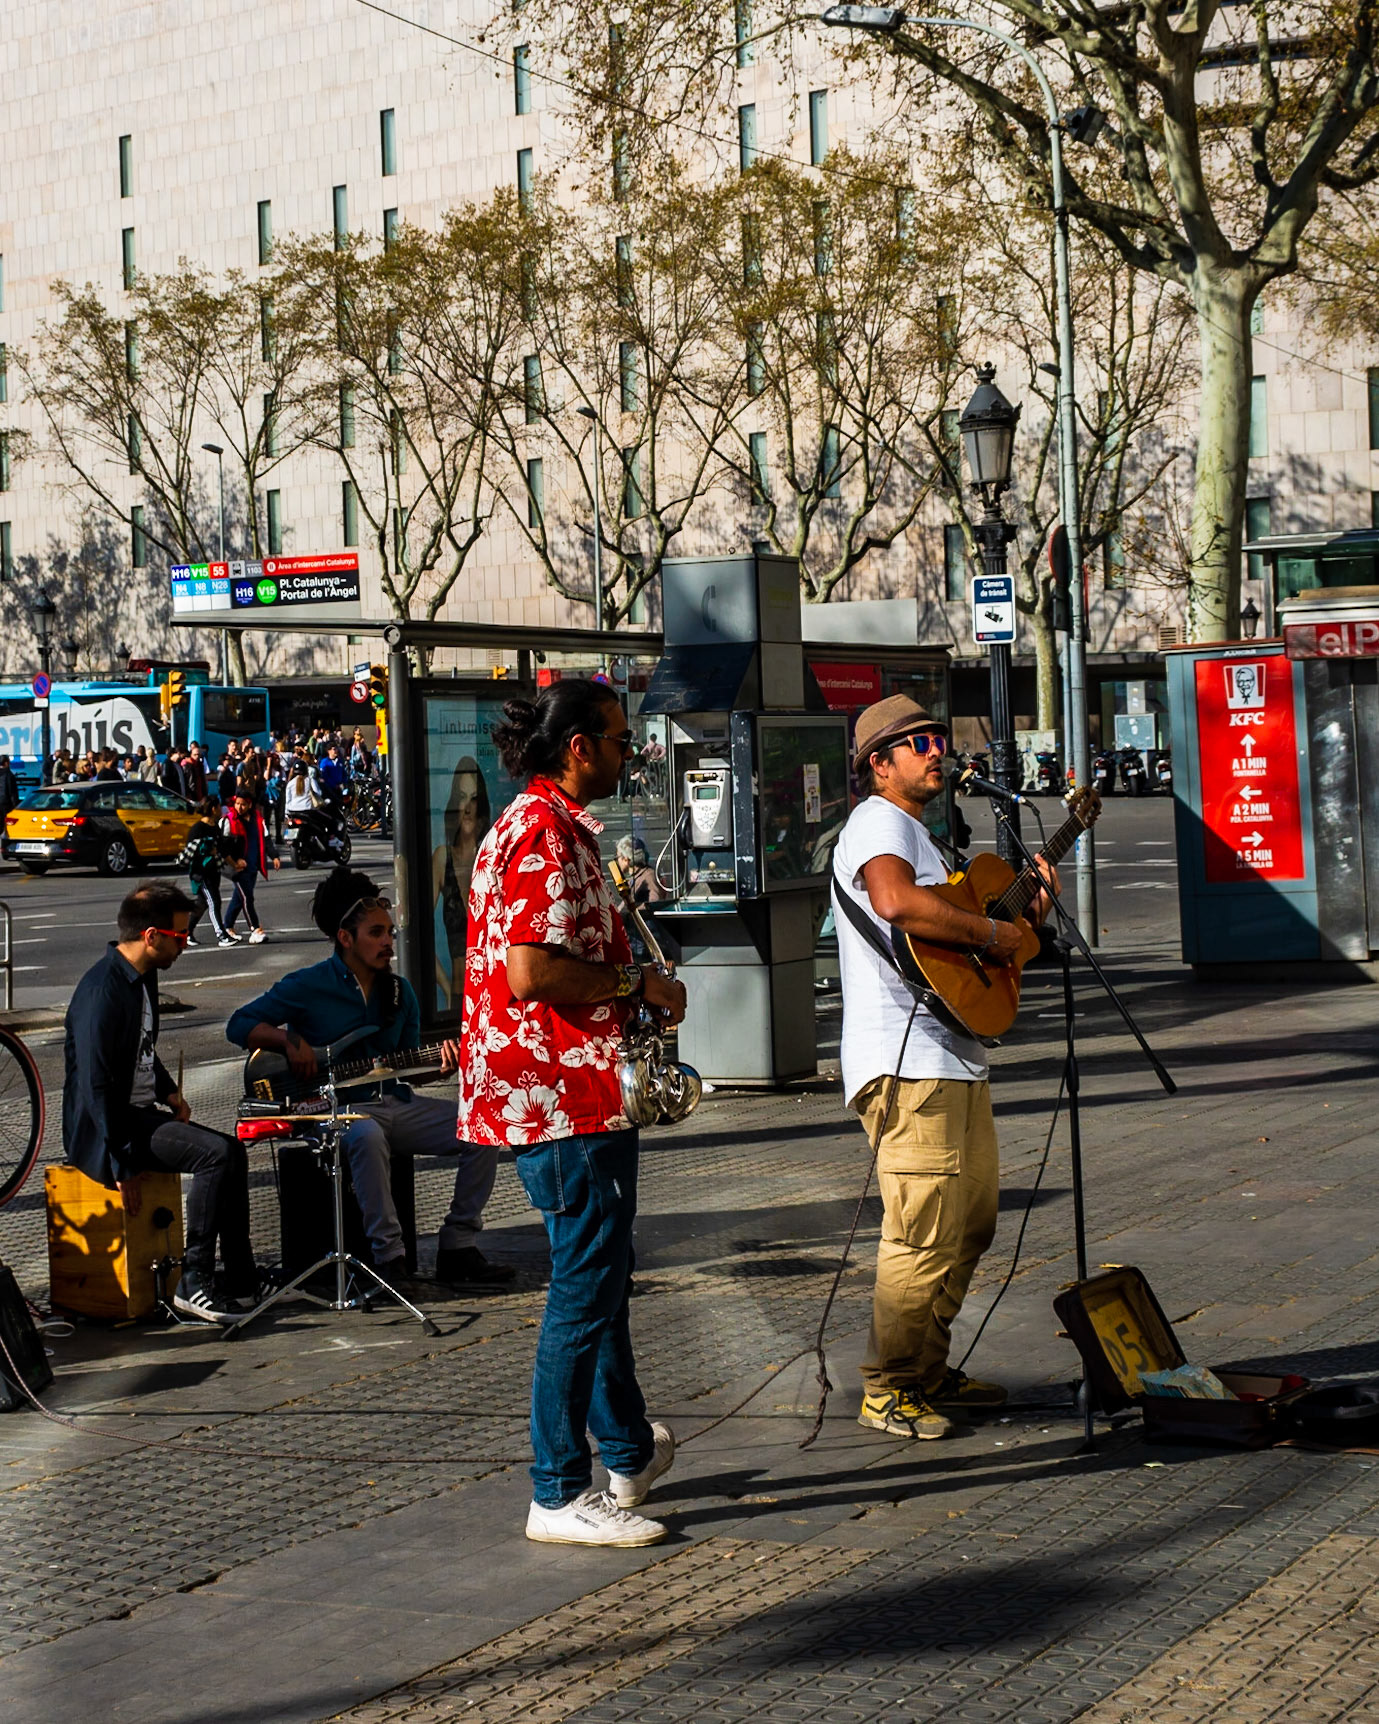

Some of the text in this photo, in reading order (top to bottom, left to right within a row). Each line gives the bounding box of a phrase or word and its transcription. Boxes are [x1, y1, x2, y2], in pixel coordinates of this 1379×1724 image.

[326, 558, 355, 567] Catalunya
[171, 568, 190, 579] H16
[190, 567, 208, 578] V15
[212, 565, 225, 577] 55
[176, 584, 188, 592] N4
[195, 582, 207, 591] N8
[279, 578, 291, 589] Pl.
[235, 587, 254, 598] H16
[258, 585, 276, 596] V15
[280, 588, 308, 600] Portal
[310, 588, 322, 598] de
[1229, 711, 1265, 727] KFC
[1232, 756, 1267, 770] A 1 MIN
[1233, 802, 1270, 816] A 2 MIN
[1236, 848, 1273, 862] A 5 MIN
